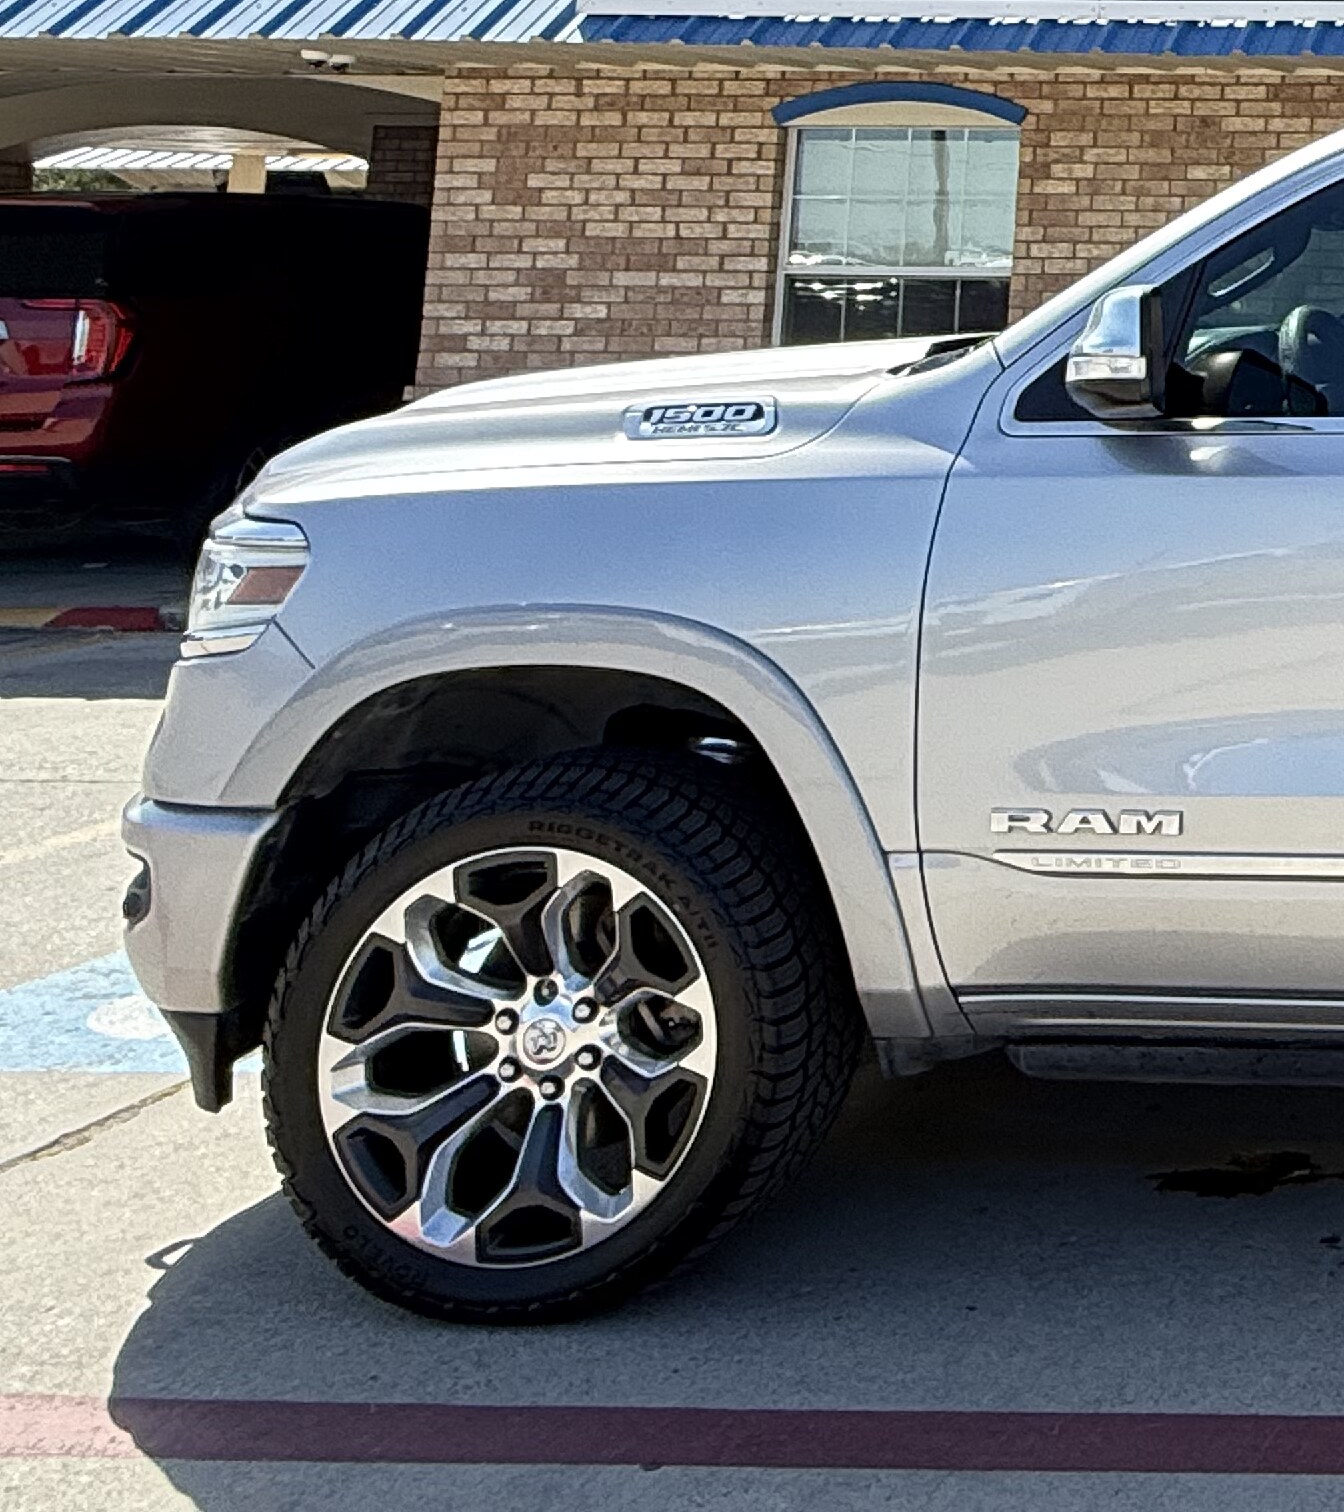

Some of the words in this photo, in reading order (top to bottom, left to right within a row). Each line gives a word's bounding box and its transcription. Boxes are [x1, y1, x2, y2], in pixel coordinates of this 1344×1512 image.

[649, 404, 758, 424] 1500
[990, 807, 1184, 836] RAM
[1031, 856, 1182, 870] LIMITED
